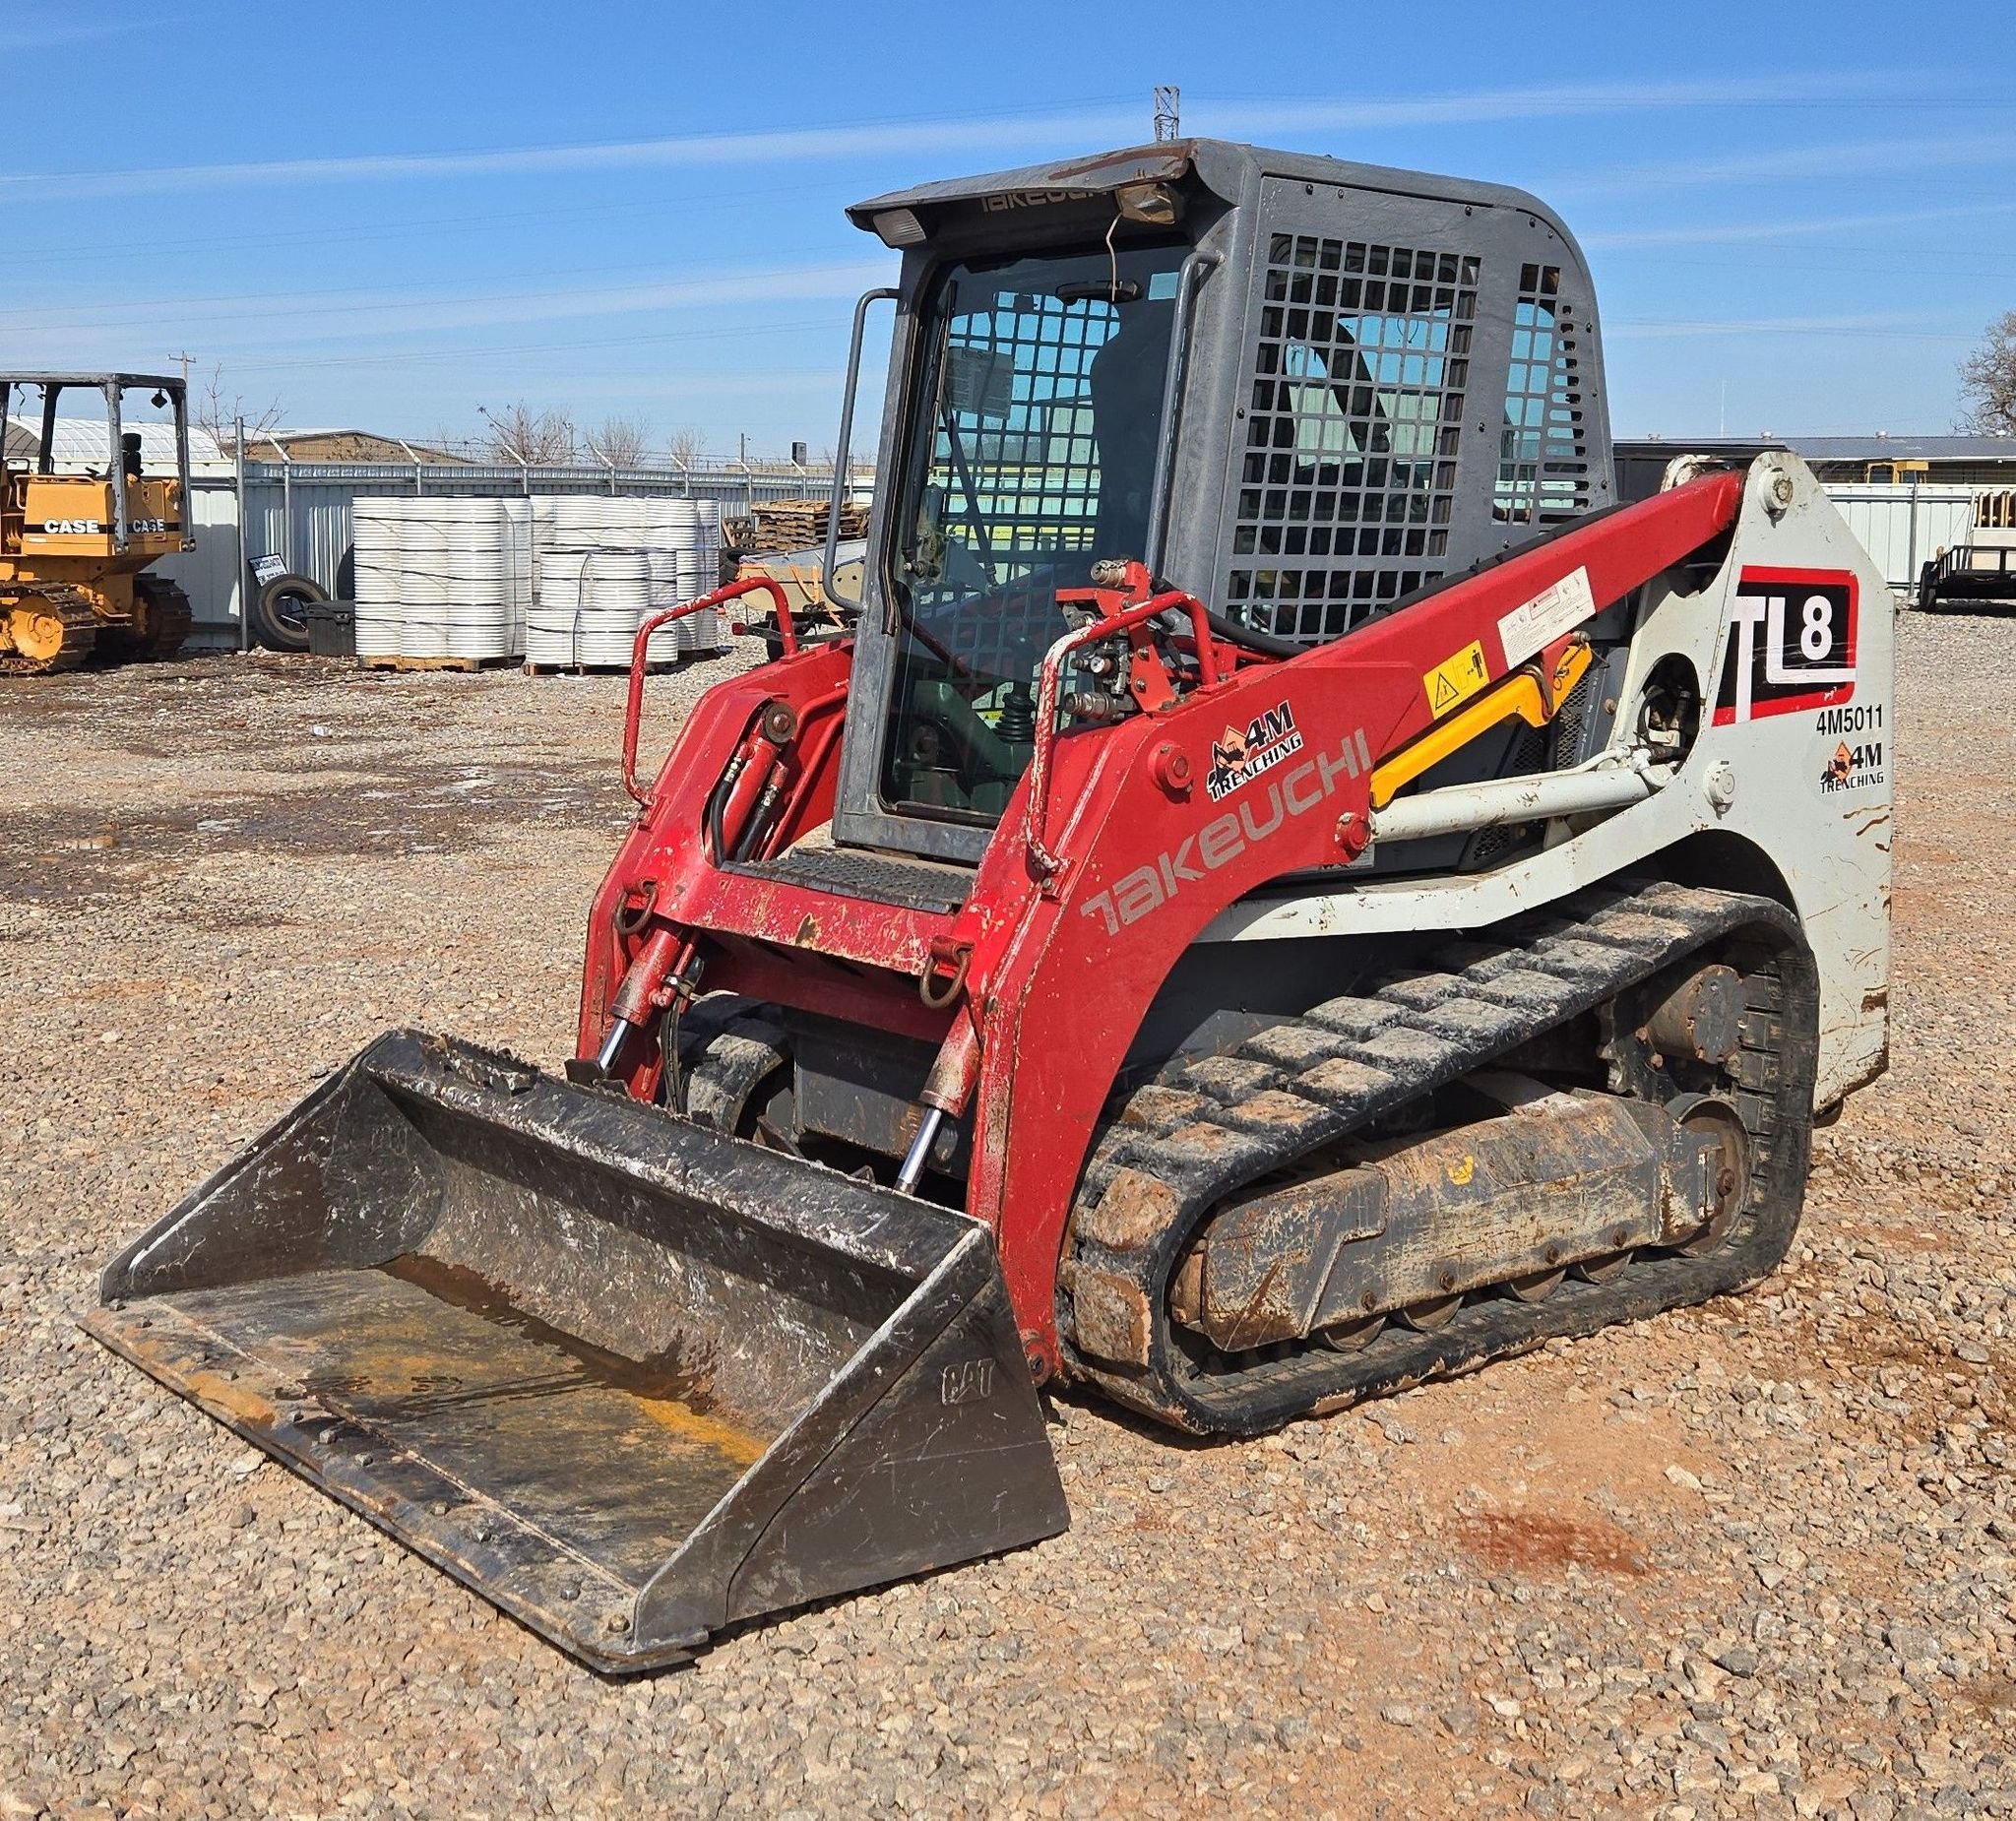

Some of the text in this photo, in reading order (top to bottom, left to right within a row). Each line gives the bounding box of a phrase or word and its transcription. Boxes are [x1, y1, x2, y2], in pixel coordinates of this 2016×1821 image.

[44, 519, 99, 534] CASE
[133, 518, 164, 533] CASE
[1730, 595, 1857, 723] TL8
[1245, 701, 1294, 748] 4M
[1816, 704, 1883, 736] 4M5011
[1208, 731, 1302, 800] TRENCHING
[1850, 742, 1882, 770] 4M
[1820, 771, 1884, 794] TRENCHING
